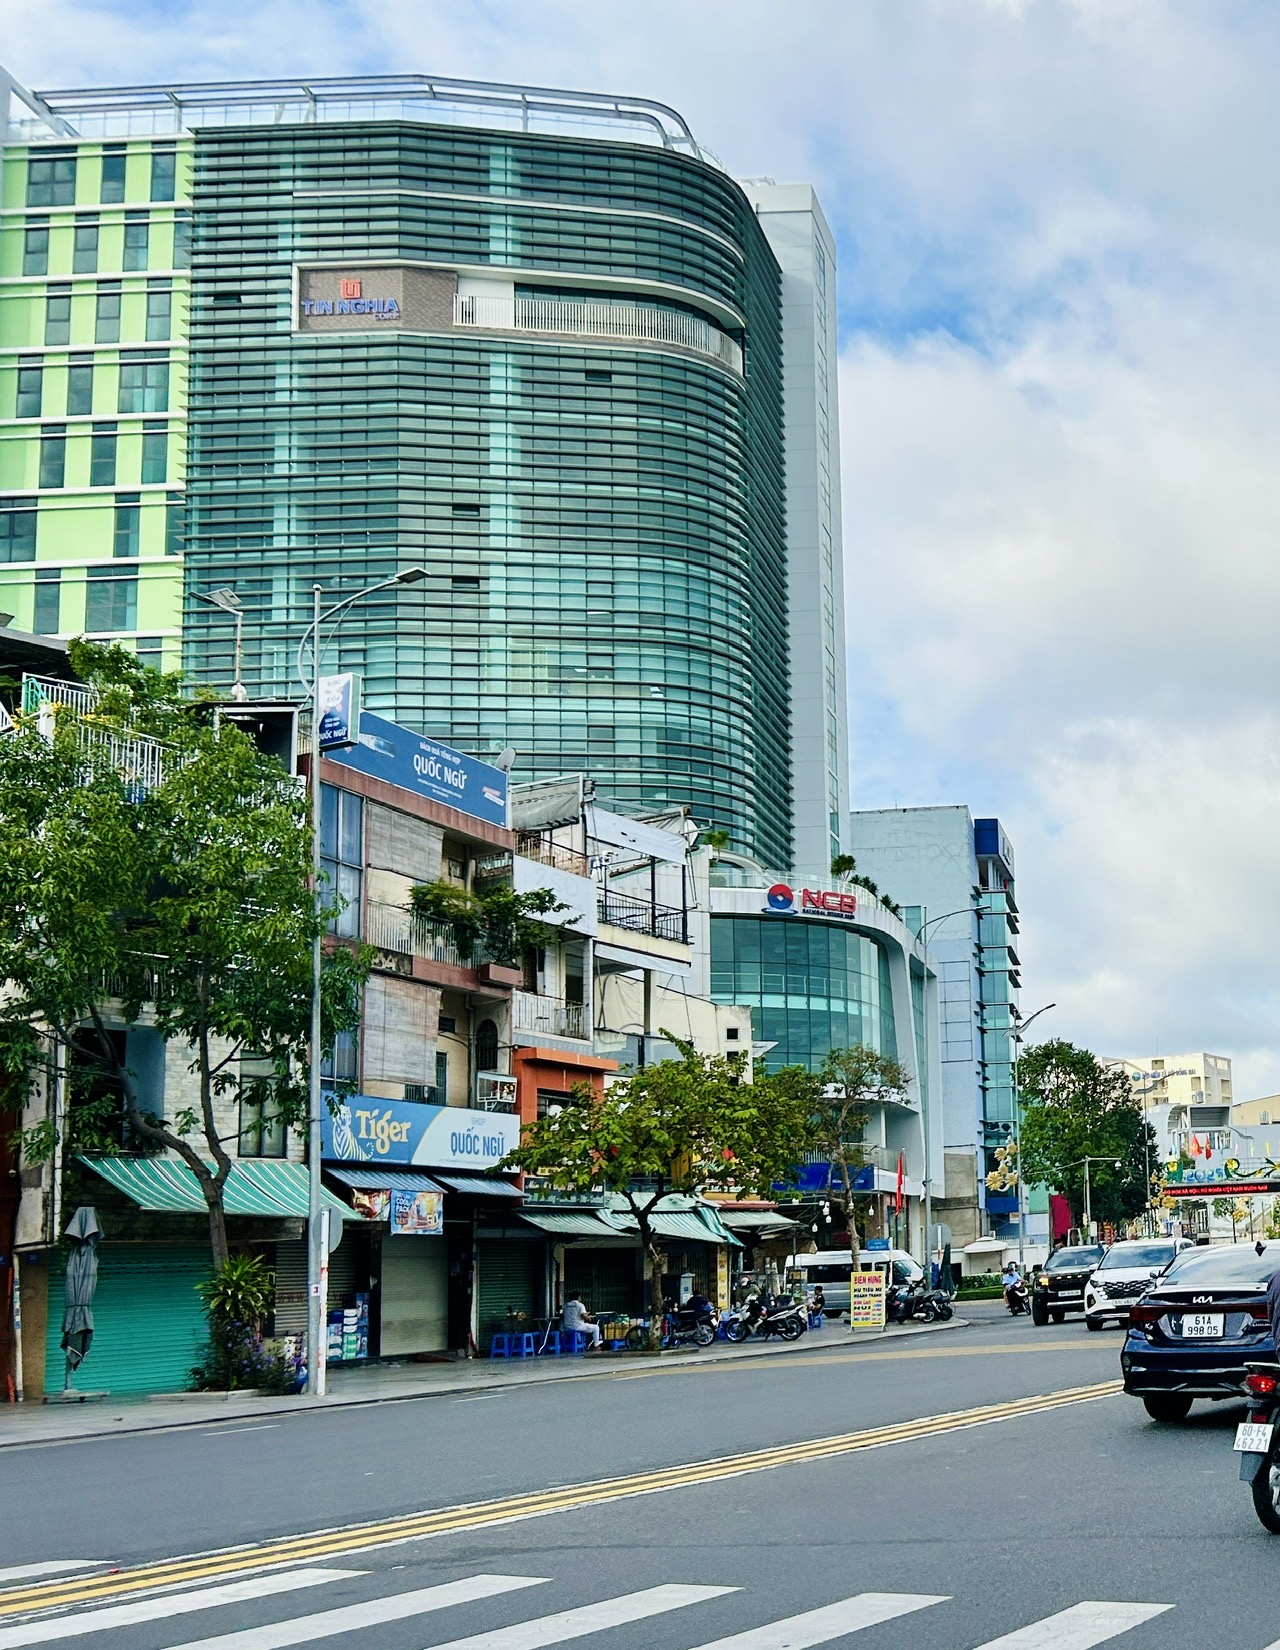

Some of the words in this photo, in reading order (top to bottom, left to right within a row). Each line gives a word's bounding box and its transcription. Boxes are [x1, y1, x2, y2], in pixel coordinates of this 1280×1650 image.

[319, 729, 333, 741] UỐC
[413, 753, 442, 781] QUỐC
[444, 769, 468, 790] NGỮ
[802, 888, 857, 914] NCB
[471, 1116, 486, 1126] SHOP
[355, 1108, 411, 1154] Tiger
[451, 1126, 480, 1156] QUỐC
[482, 1131, 506, 1157] NGỮ
[1187, 1168, 1223, 1181] 2025
[1192, 1295, 1213, 1304] KIA
[1195, 1315, 1212, 1325] 61A
